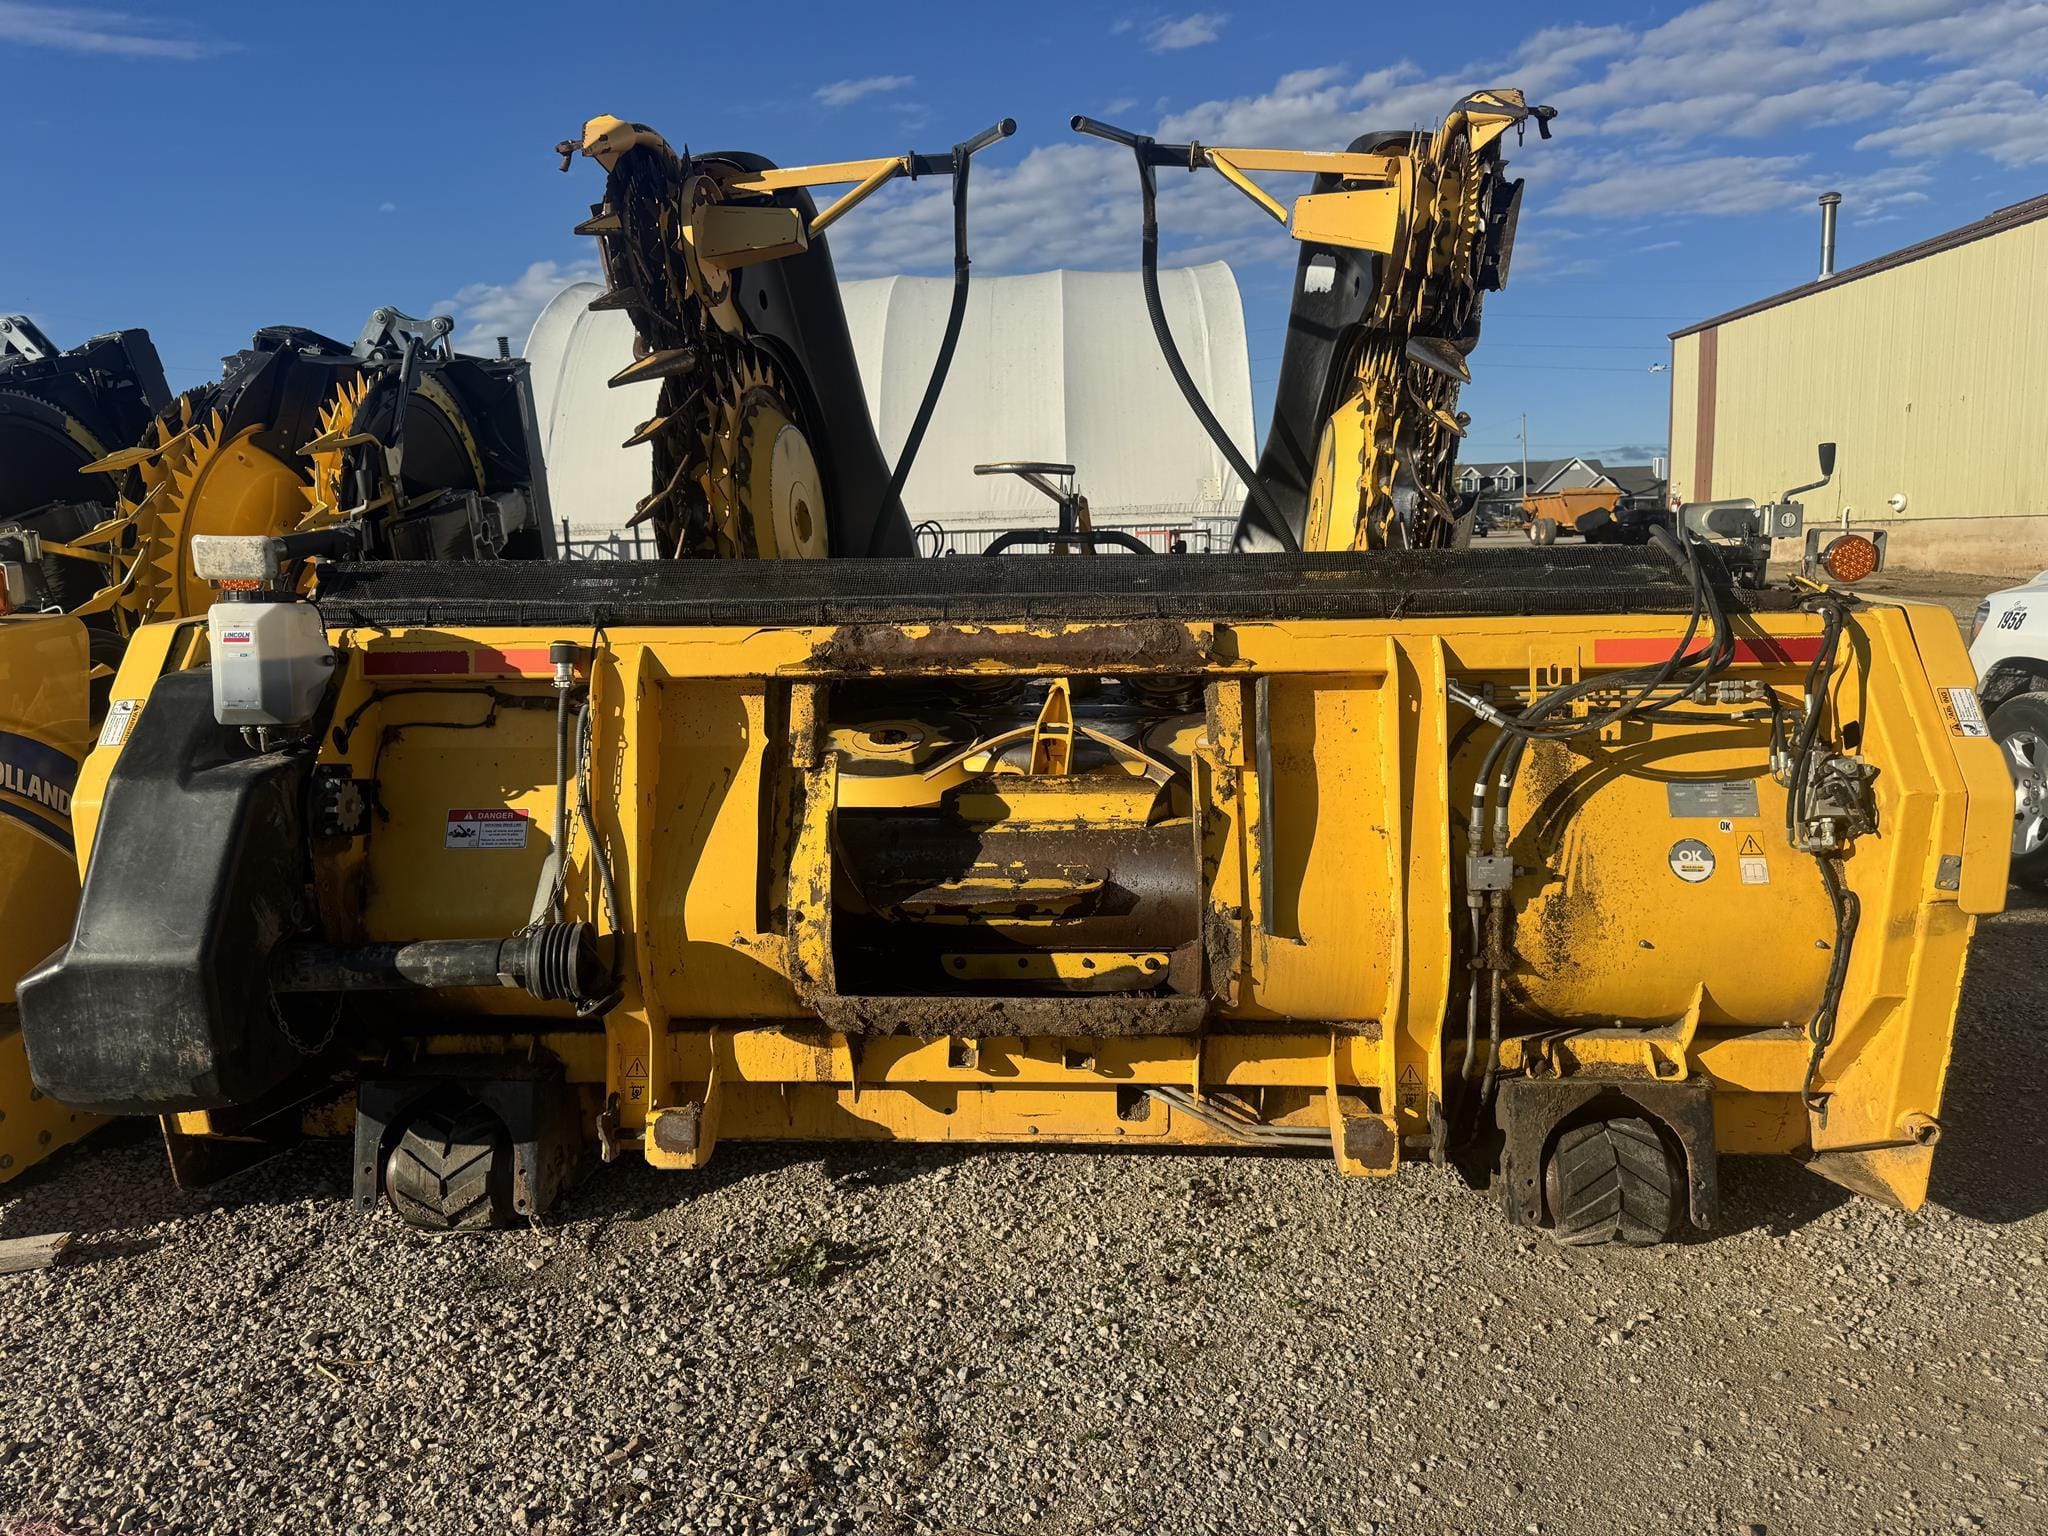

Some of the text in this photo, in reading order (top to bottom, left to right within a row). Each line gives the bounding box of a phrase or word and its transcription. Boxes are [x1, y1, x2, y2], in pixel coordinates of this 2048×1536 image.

[1997, 611, 2027, 630] 1958
[477, 812, 514, 820] DANGER
[1719, 821, 1731, 831] OK
[1678, 850, 1704, 862] OK
